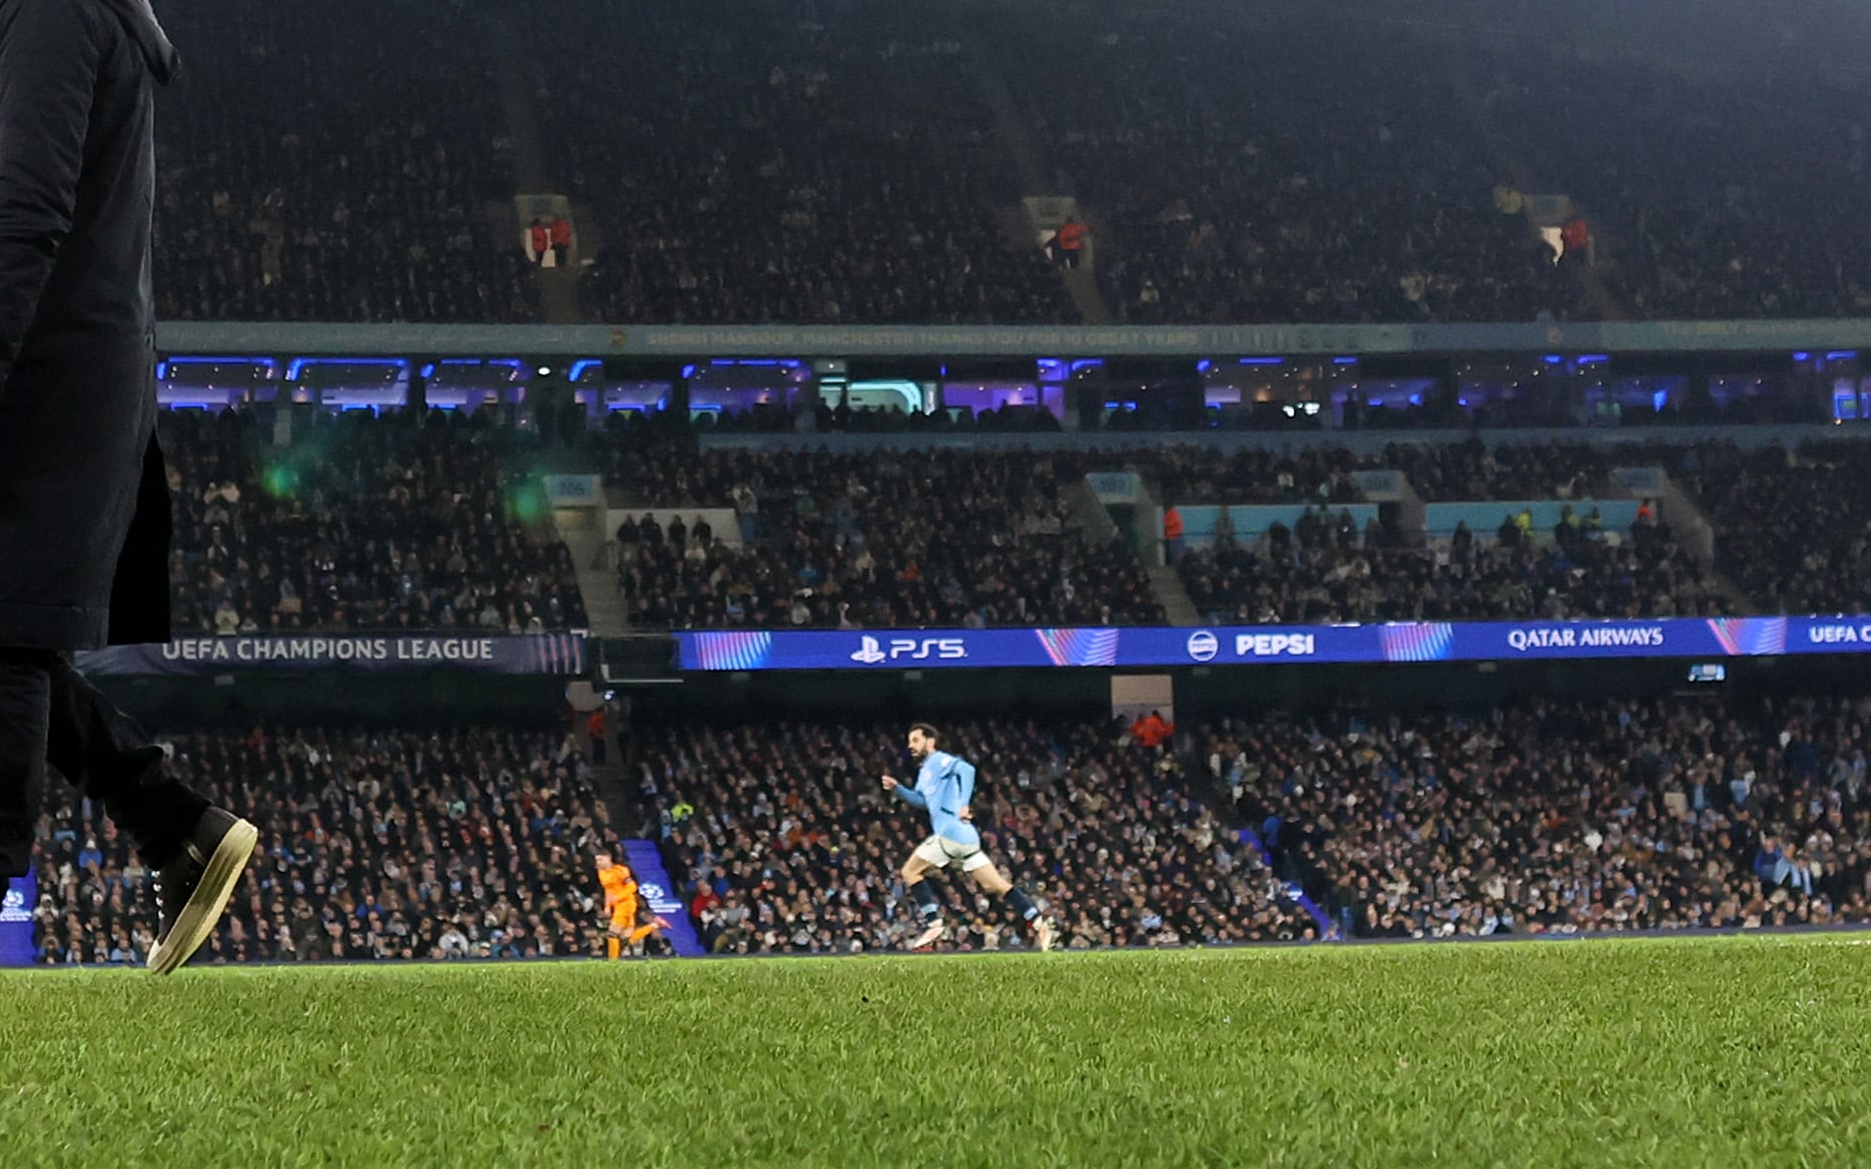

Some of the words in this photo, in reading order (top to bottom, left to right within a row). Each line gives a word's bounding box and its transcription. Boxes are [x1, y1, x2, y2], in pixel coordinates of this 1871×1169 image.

[1507, 629, 1576, 651] QATAR
[1580, 627, 1665, 646] AIRWAYS
[1809, 625, 1859, 643] UEFA
[162, 639, 229, 660] UEFA
[236, 639, 387, 660] CHAMPIONS
[397, 639, 493, 660] LEAGUE
[890, 639, 965, 659] PS5
[1235, 634, 1315, 656] PEPSI
